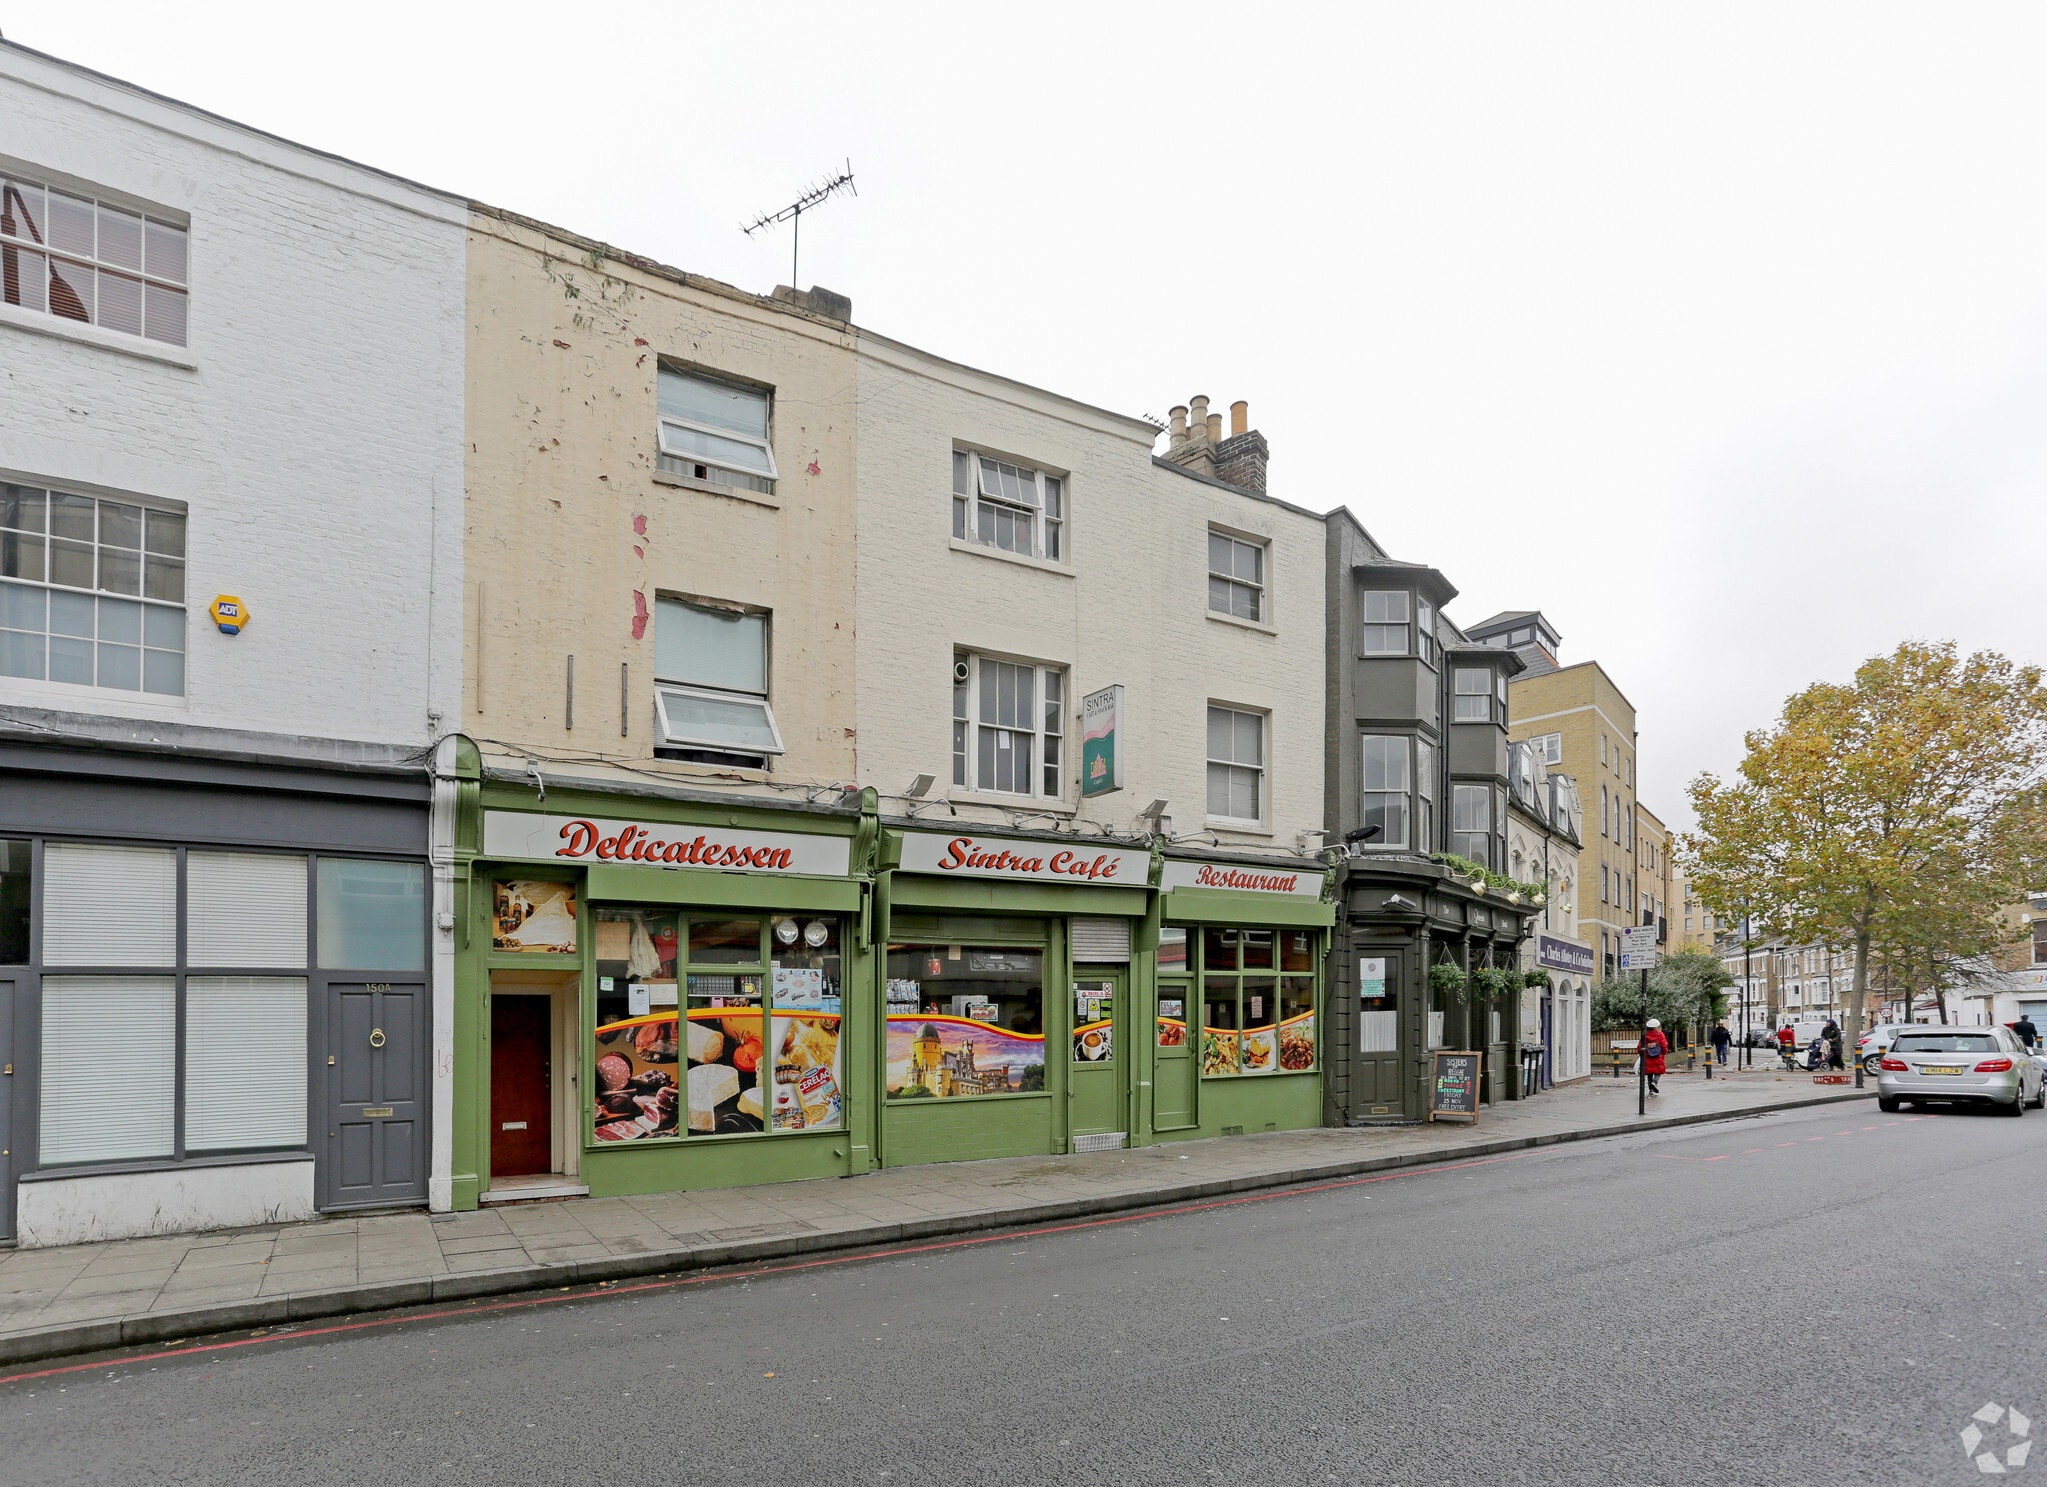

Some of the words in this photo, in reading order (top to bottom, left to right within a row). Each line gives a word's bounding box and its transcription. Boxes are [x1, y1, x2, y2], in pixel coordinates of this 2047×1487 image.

[220, 604, 237, 616] ADT
[1086, 691, 1114, 712] SINTRA
[556, 820, 794, 869] Delicatessen
[938, 837, 1044, 873] Sintra
[1050, 850, 1121, 880] Café
[1195, 864, 1298, 892] Restaurant
[1546, 944, 1560, 962] Charles
[1576, 952, 1580, 966] Co
[366, 984, 391, 992] 150A
[799, 1070, 831, 1090] CERELAC
